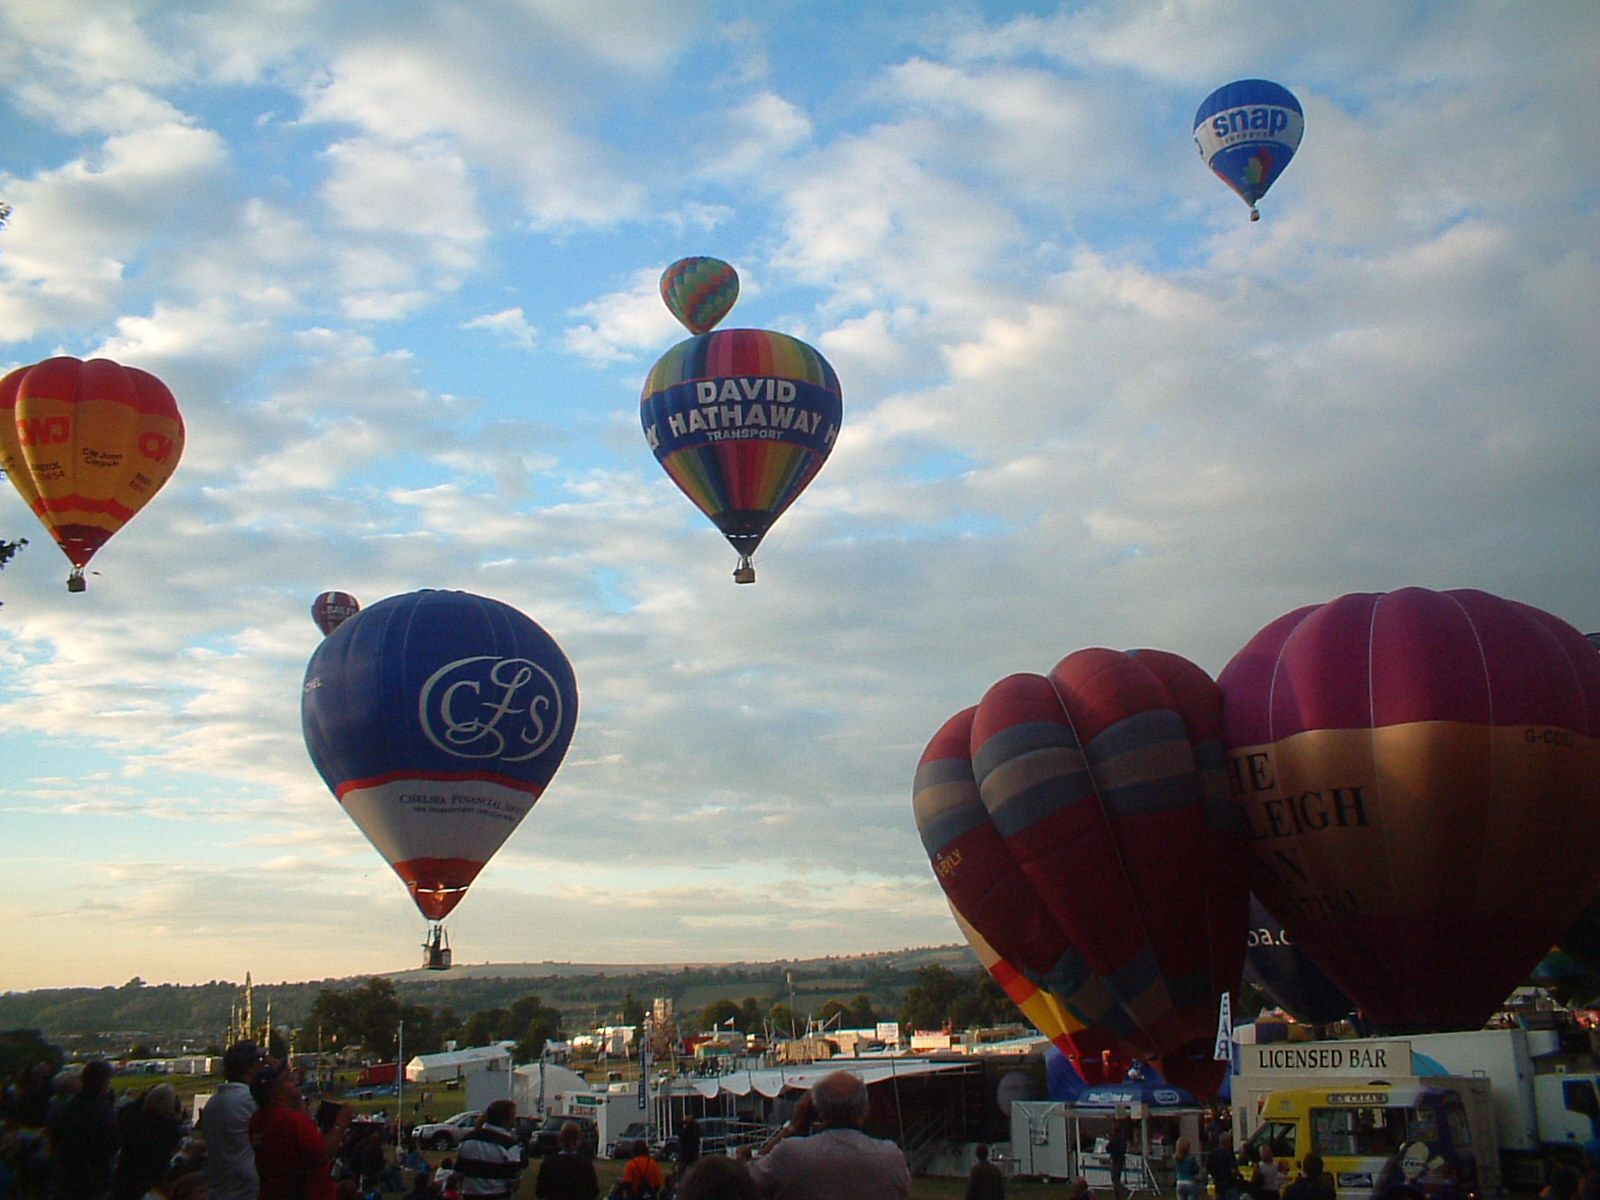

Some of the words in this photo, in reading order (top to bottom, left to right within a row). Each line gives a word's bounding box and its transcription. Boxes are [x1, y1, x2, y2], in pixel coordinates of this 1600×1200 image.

[1213, 108, 1288, 137] snap
[696, 378, 797, 404] DAVID
[668, 404, 823, 438] HATHAWAY
[706, 428, 784, 441] TRANSPORT
[400, 794, 447, 804] CHELSEA
[452, 794, 501, 810] FINANCIAL
[1259, 1050, 1342, 1069] LICENSED
[1350, 1049, 1387, 1068] BAR
